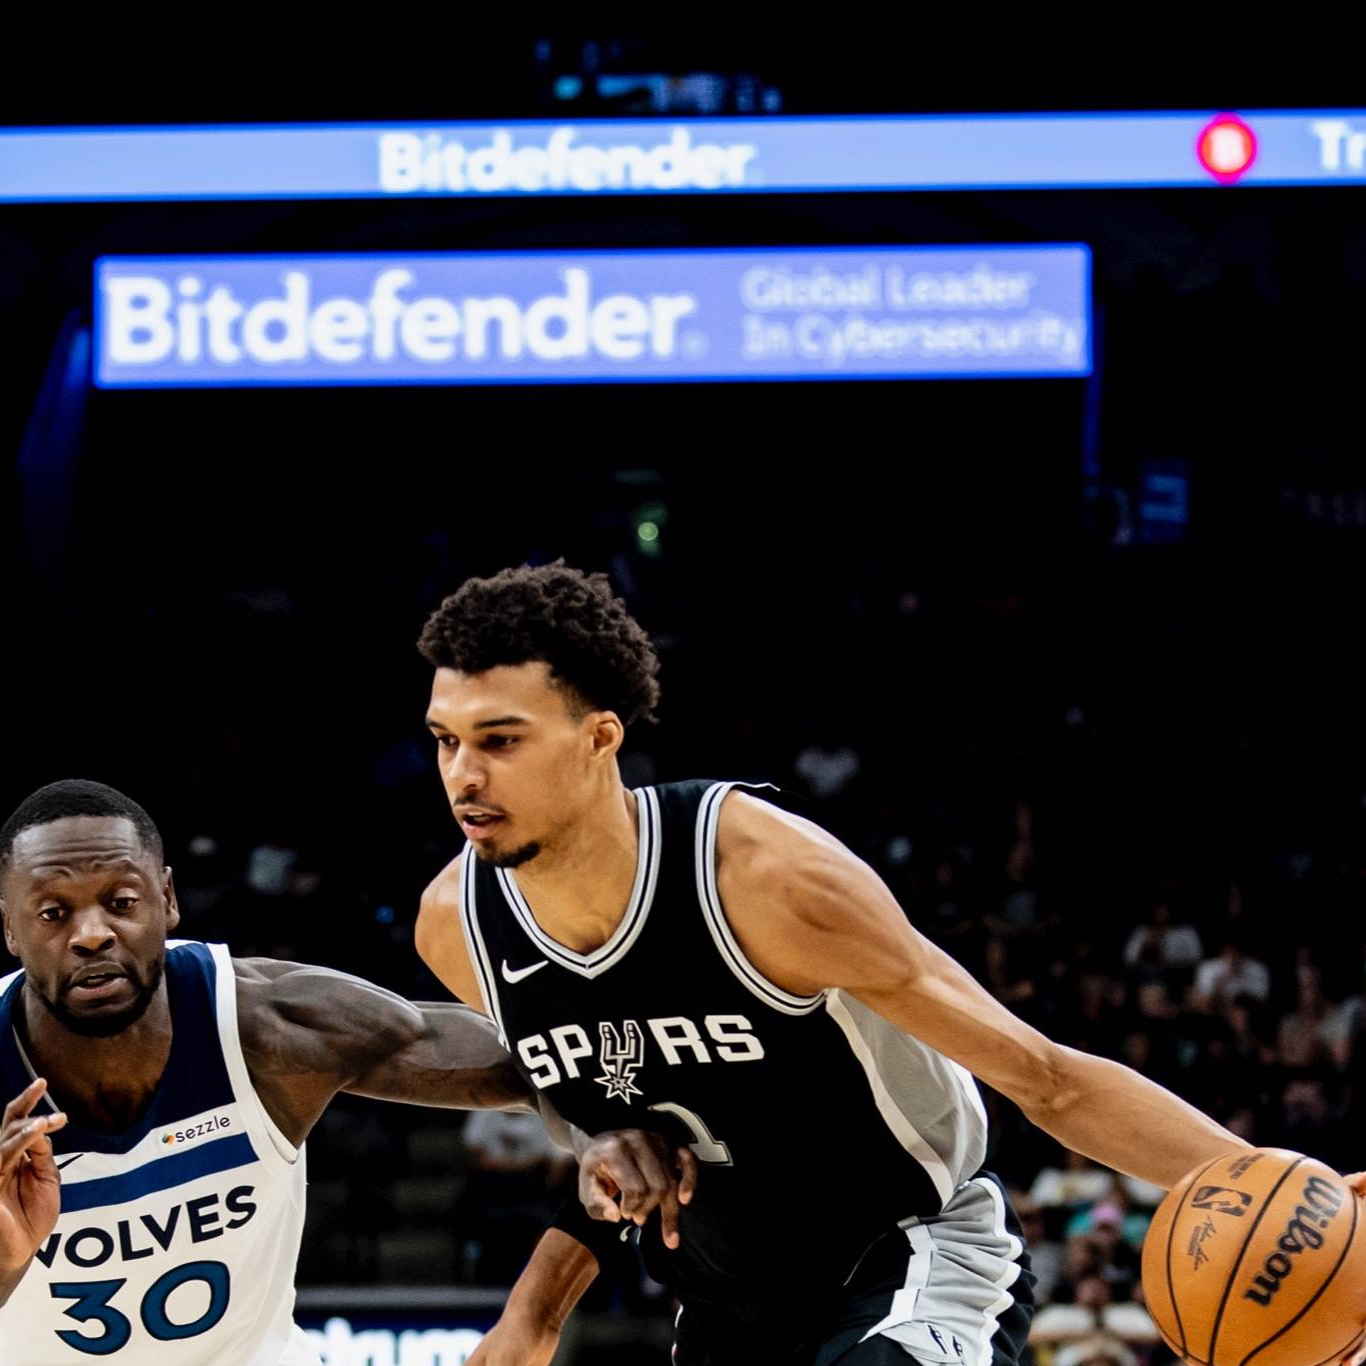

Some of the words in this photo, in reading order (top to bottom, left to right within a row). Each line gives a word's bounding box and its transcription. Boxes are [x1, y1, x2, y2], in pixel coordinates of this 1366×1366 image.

[379, 125, 756, 192] Bitdefender
[105, 267, 697, 363] Bitdefender
[739, 264, 883, 312] Global
[887, 262, 1032, 310] Leader
[793, 307, 1081, 368] Cybersecurity
[517, 1014, 765, 1105] SPURS
[175, 1115, 231, 1142] sezzle
[1243, 1175, 1343, 1307] Wilson
[49, 1260, 231, 1356] 30
